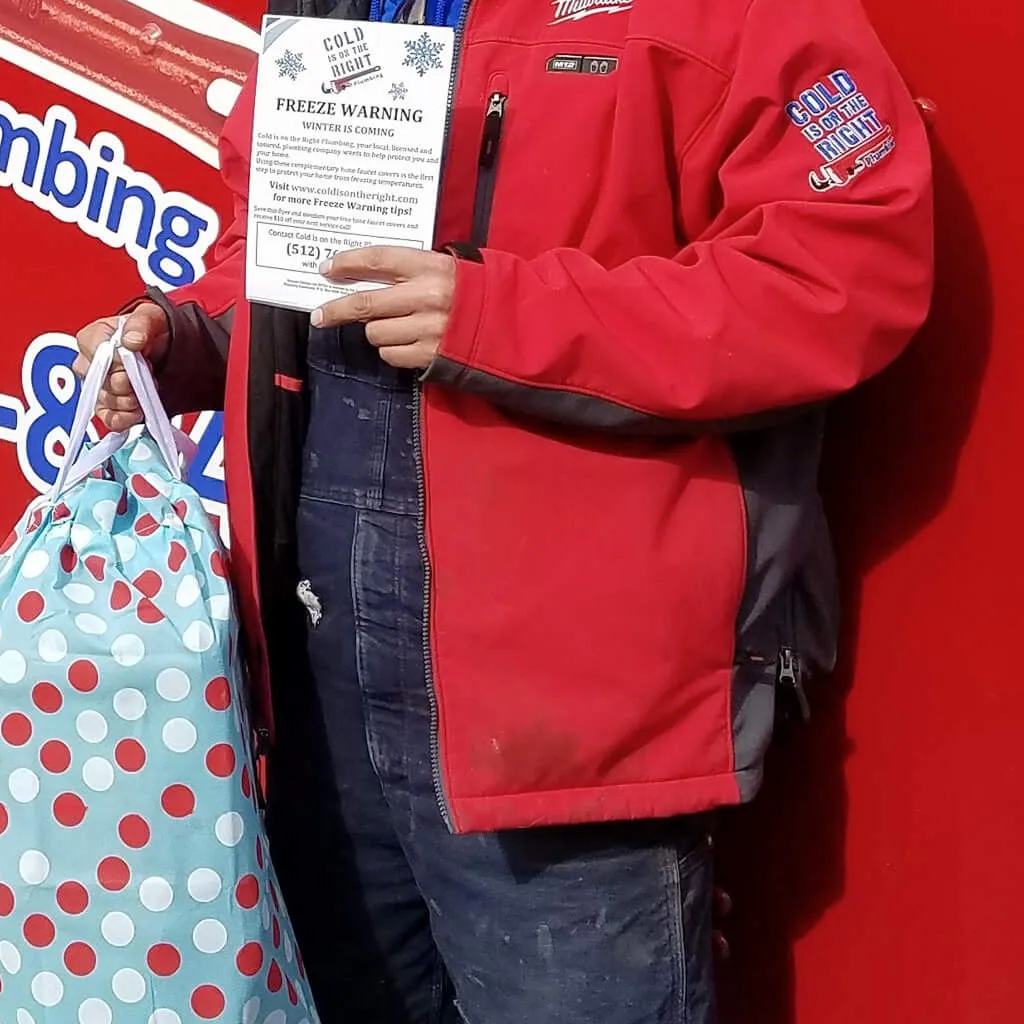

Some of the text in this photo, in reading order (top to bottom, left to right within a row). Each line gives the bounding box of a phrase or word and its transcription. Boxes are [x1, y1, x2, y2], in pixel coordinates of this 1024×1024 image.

[323, 26, 364, 51] COLD
[328, 54, 337, 63] IS
[352, 42, 368, 54] THE
[331, 53, 371, 77] RIGHT
[276, 97, 423, 122] FREEZE WARNING
[785, 69, 857, 126] COLD
[302, 121, 395, 137] WINTER IS COMING
[801, 93, 869, 142] IS ON THE
[814, 108, 882, 161] RIGHT
[371, 151, 386, 160] help
[269, 180, 419, 205] Visit www.coldisontheright.com
[273, 193, 413, 217] for more Freeze Warning tips!
[268, 228, 294, 239] Contact
[295, 232, 311, 241] Cold
[312, 233, 318, 242] is
[330, 236, 342, 245] the
[343, 238, 362, 248] Right
[286, 242, 321, 260] (512)
[302, 259, 318, 269] with
